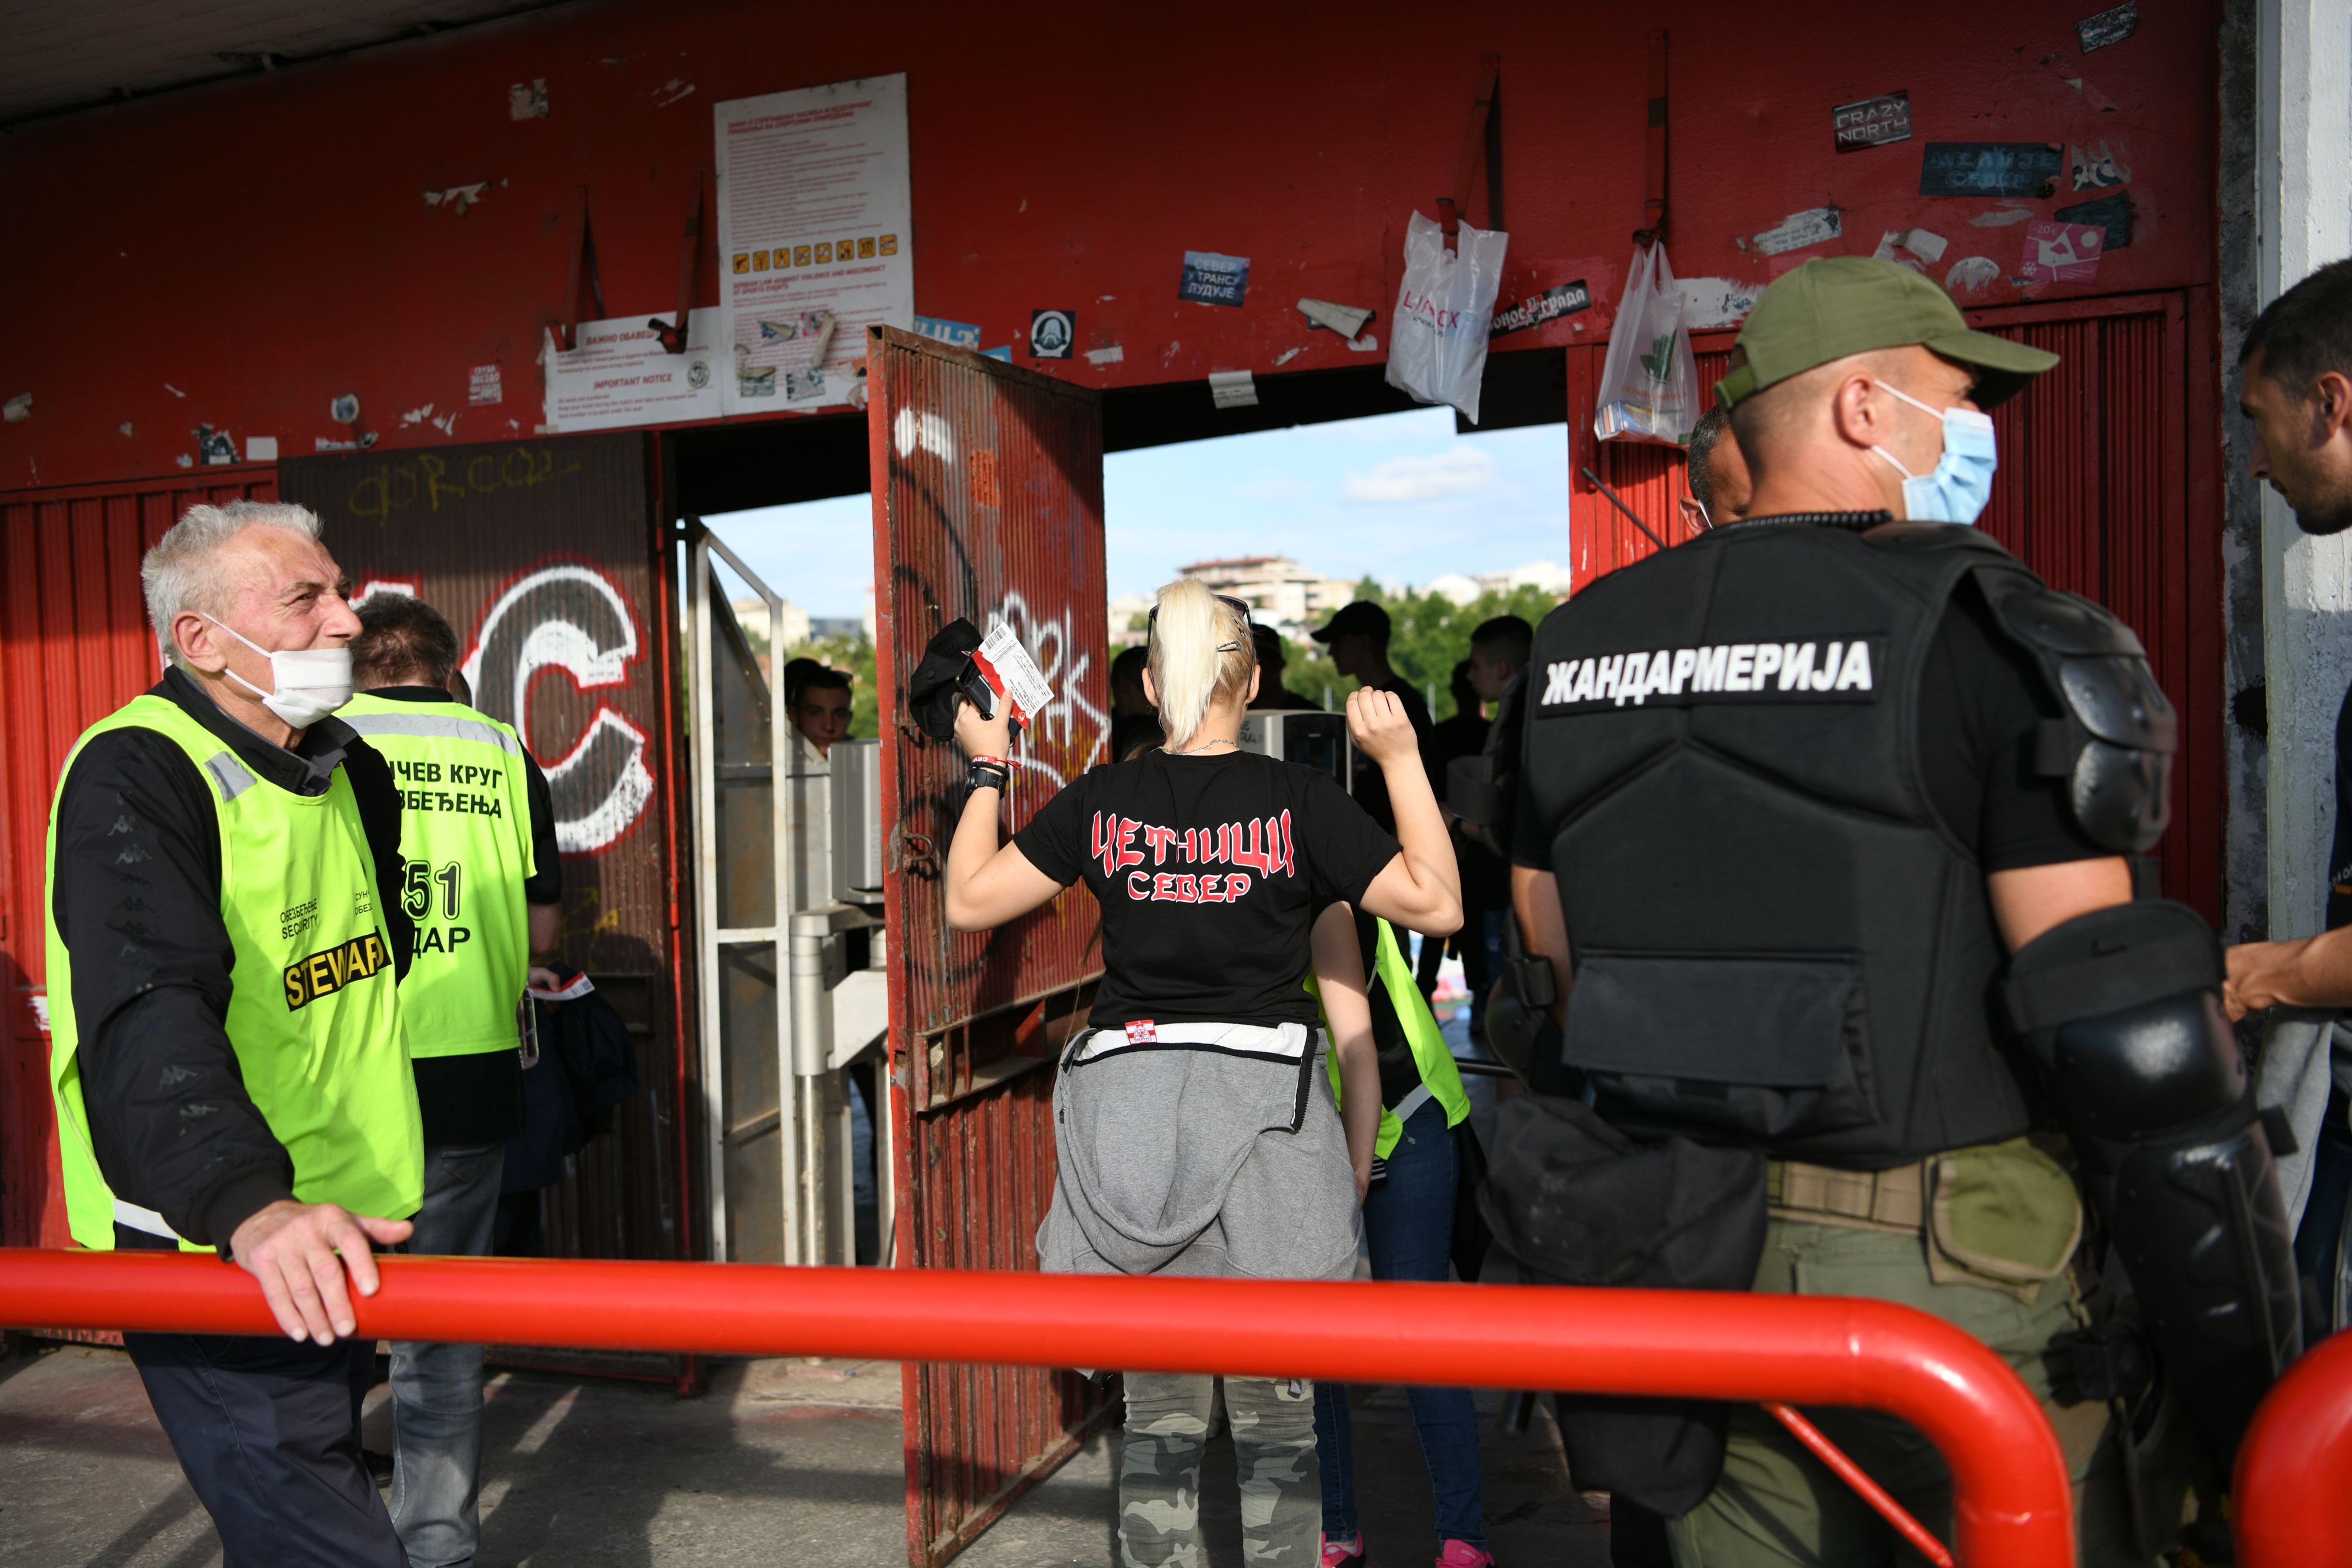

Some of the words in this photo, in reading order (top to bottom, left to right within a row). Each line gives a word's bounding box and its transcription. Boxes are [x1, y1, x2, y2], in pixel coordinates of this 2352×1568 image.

[1837, 101, 1905, 128] CRAZY
[1839, 118, 1907, 143] NORTH
[801, 271, 830, 281] VIOLENCE
[1194, 258, 1236, 272] СЕВЕР
[1188, 282, 1236, 299] ЛУДУЈЕ
[1197, 272, 1240, 286] ТРАНСУ
[1489, 307, 1525, 330] ОНОС
[620, 329, 659, 342] ОБАВЕШ
[594, 377, 640, 390] IMPORTANT
[643, 373, 673, 384] NOTICE
[1541, 640, 1873, 706] ЖАНДАРМЕРИЈА
[389, 761, 441, 783] ЧЕВ
[450, 765, 502, 788] КРУГ
[399, 790, 502, 818] ЗБЕЂЕЊА
[1091, 808, 1295, 878] ЧЕТНИЦИ
[403, 860, 460, 921] 51
[1127, 871, 1251, 904] СЕВЕР
[280, 898, 318, 923] ОБЕЗБЕЂЕЊЕ
[355, 902, 372, 915] ОБЕЗ
[282, 914, 318, 940] SECURITY
[413, 927, 470, 959] ДАР
